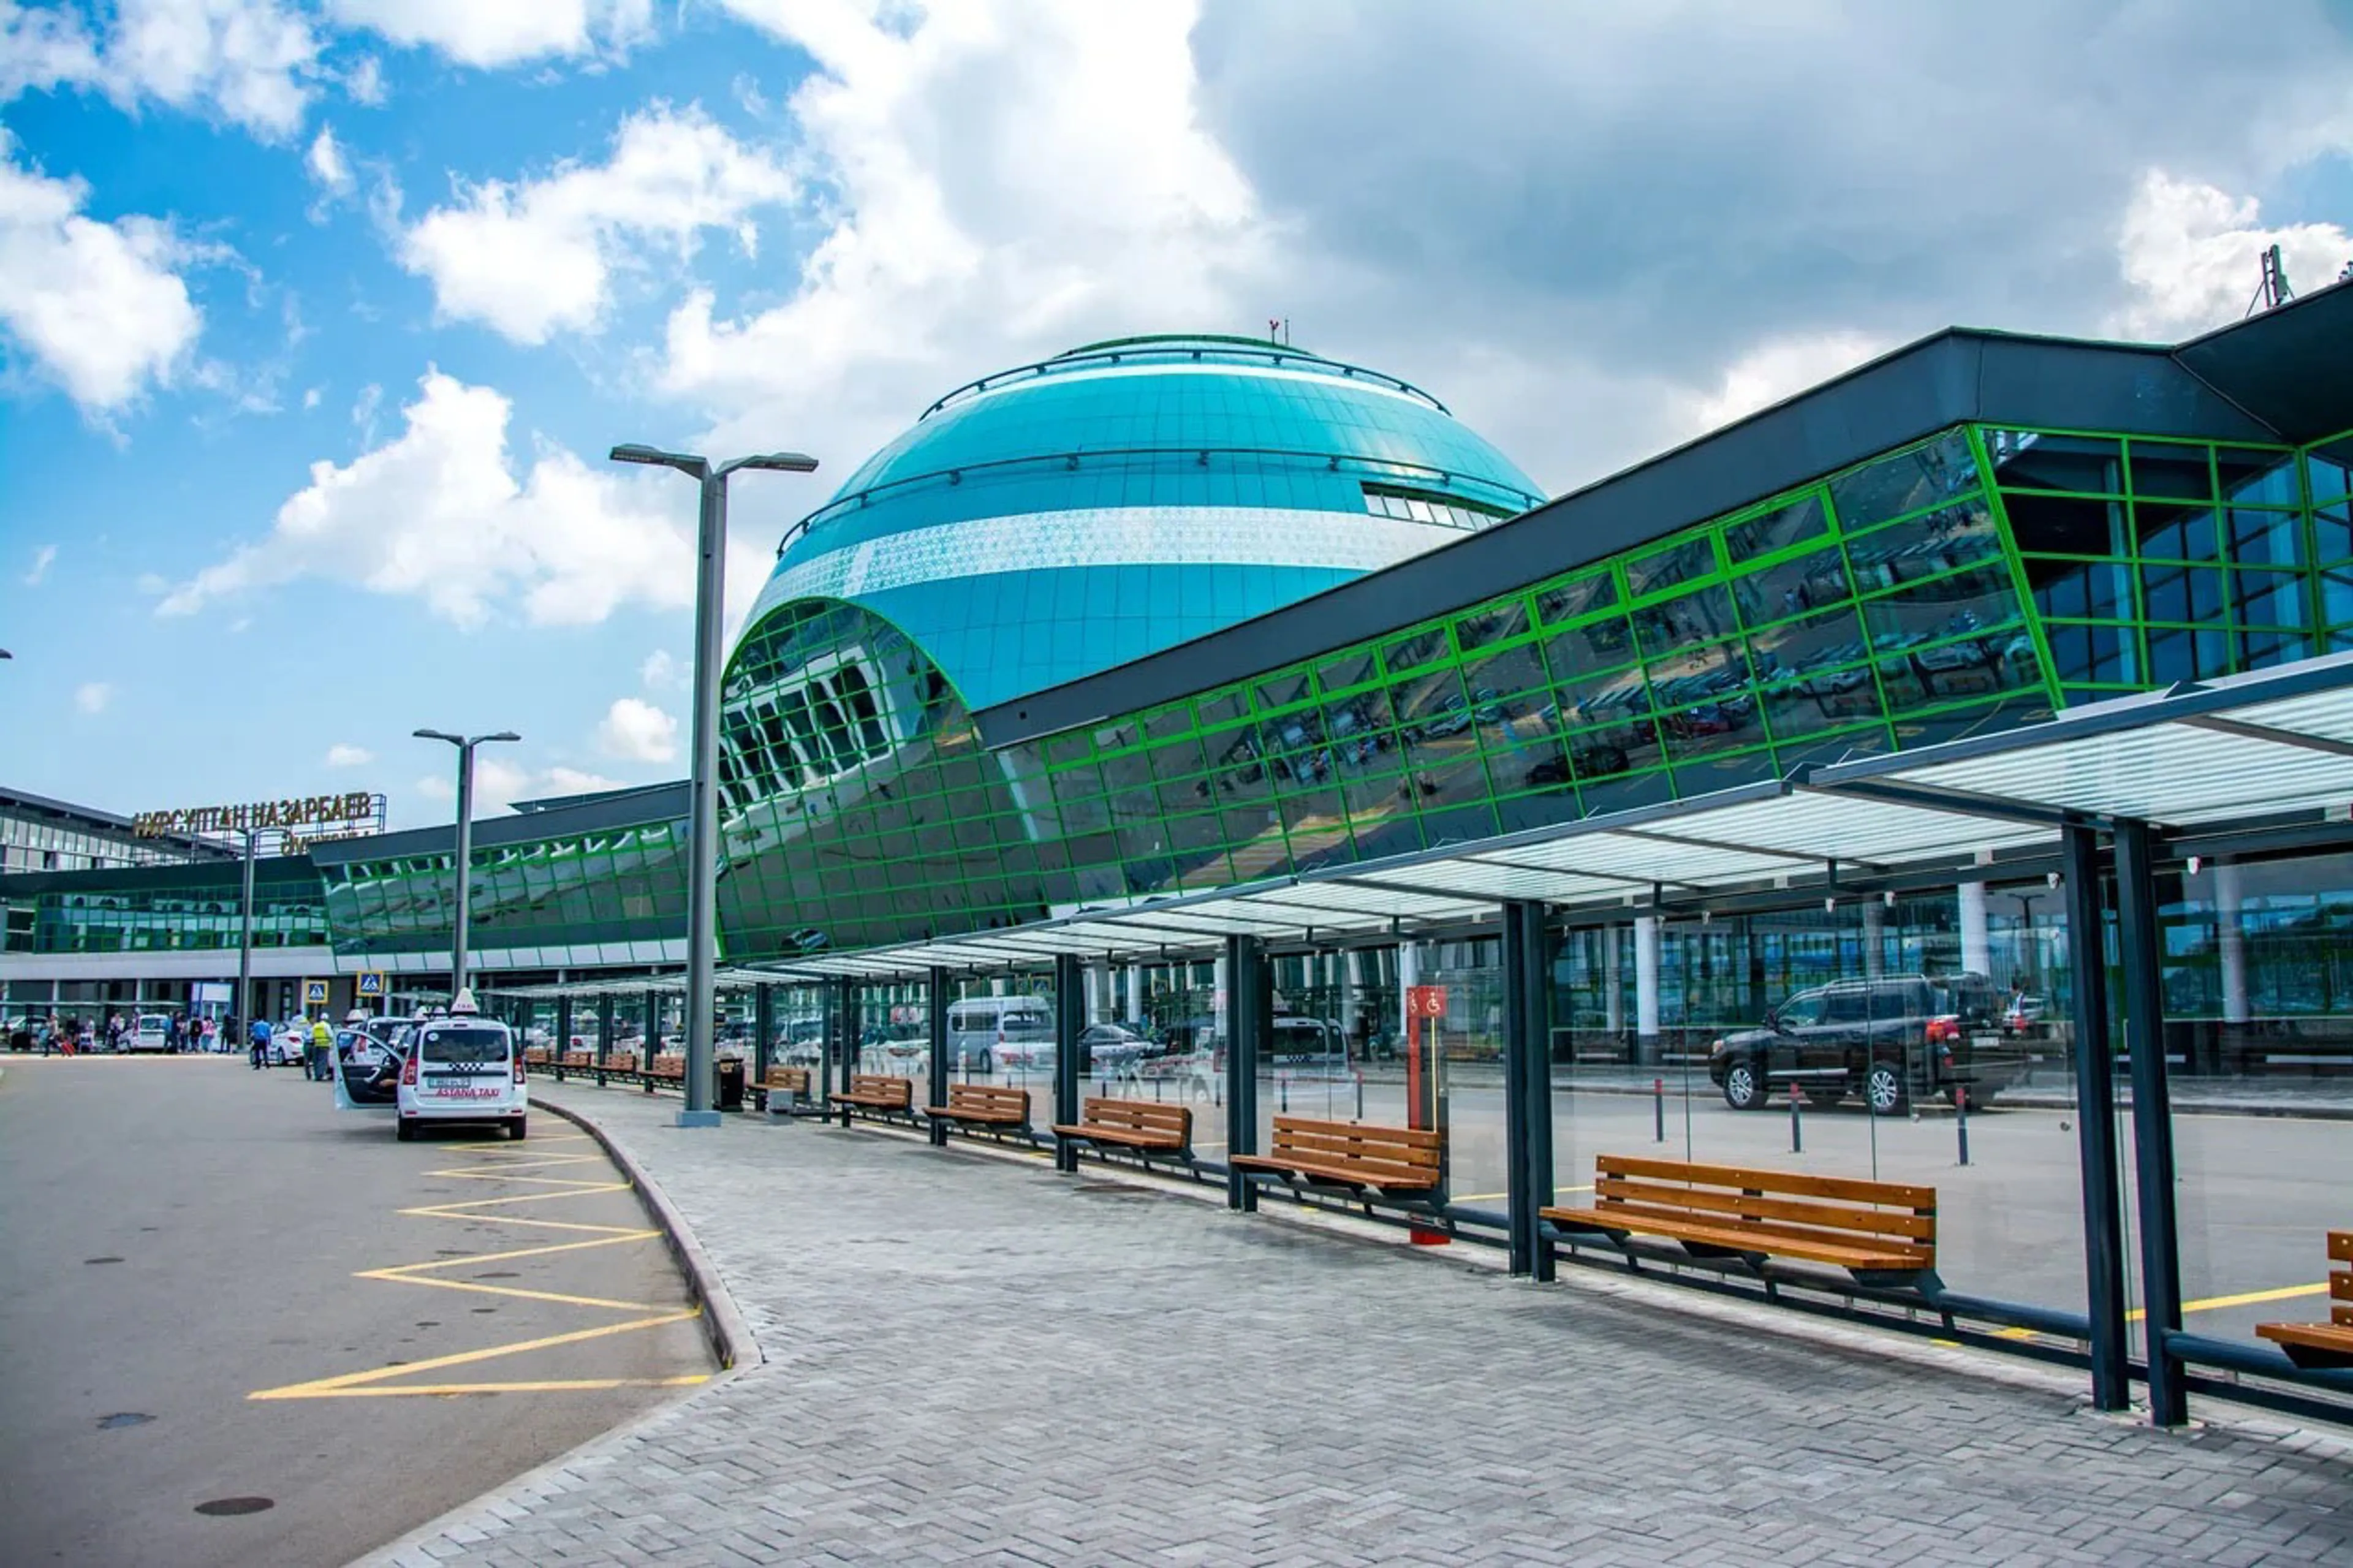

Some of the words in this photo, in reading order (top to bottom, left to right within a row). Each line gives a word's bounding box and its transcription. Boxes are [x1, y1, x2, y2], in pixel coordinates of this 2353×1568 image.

[252, 792, 370, 827] НАЗАРБАЕВ
[436, 1088, 476, 1097] ASTANA
[479, 1088, 500, 1097] TAXI
